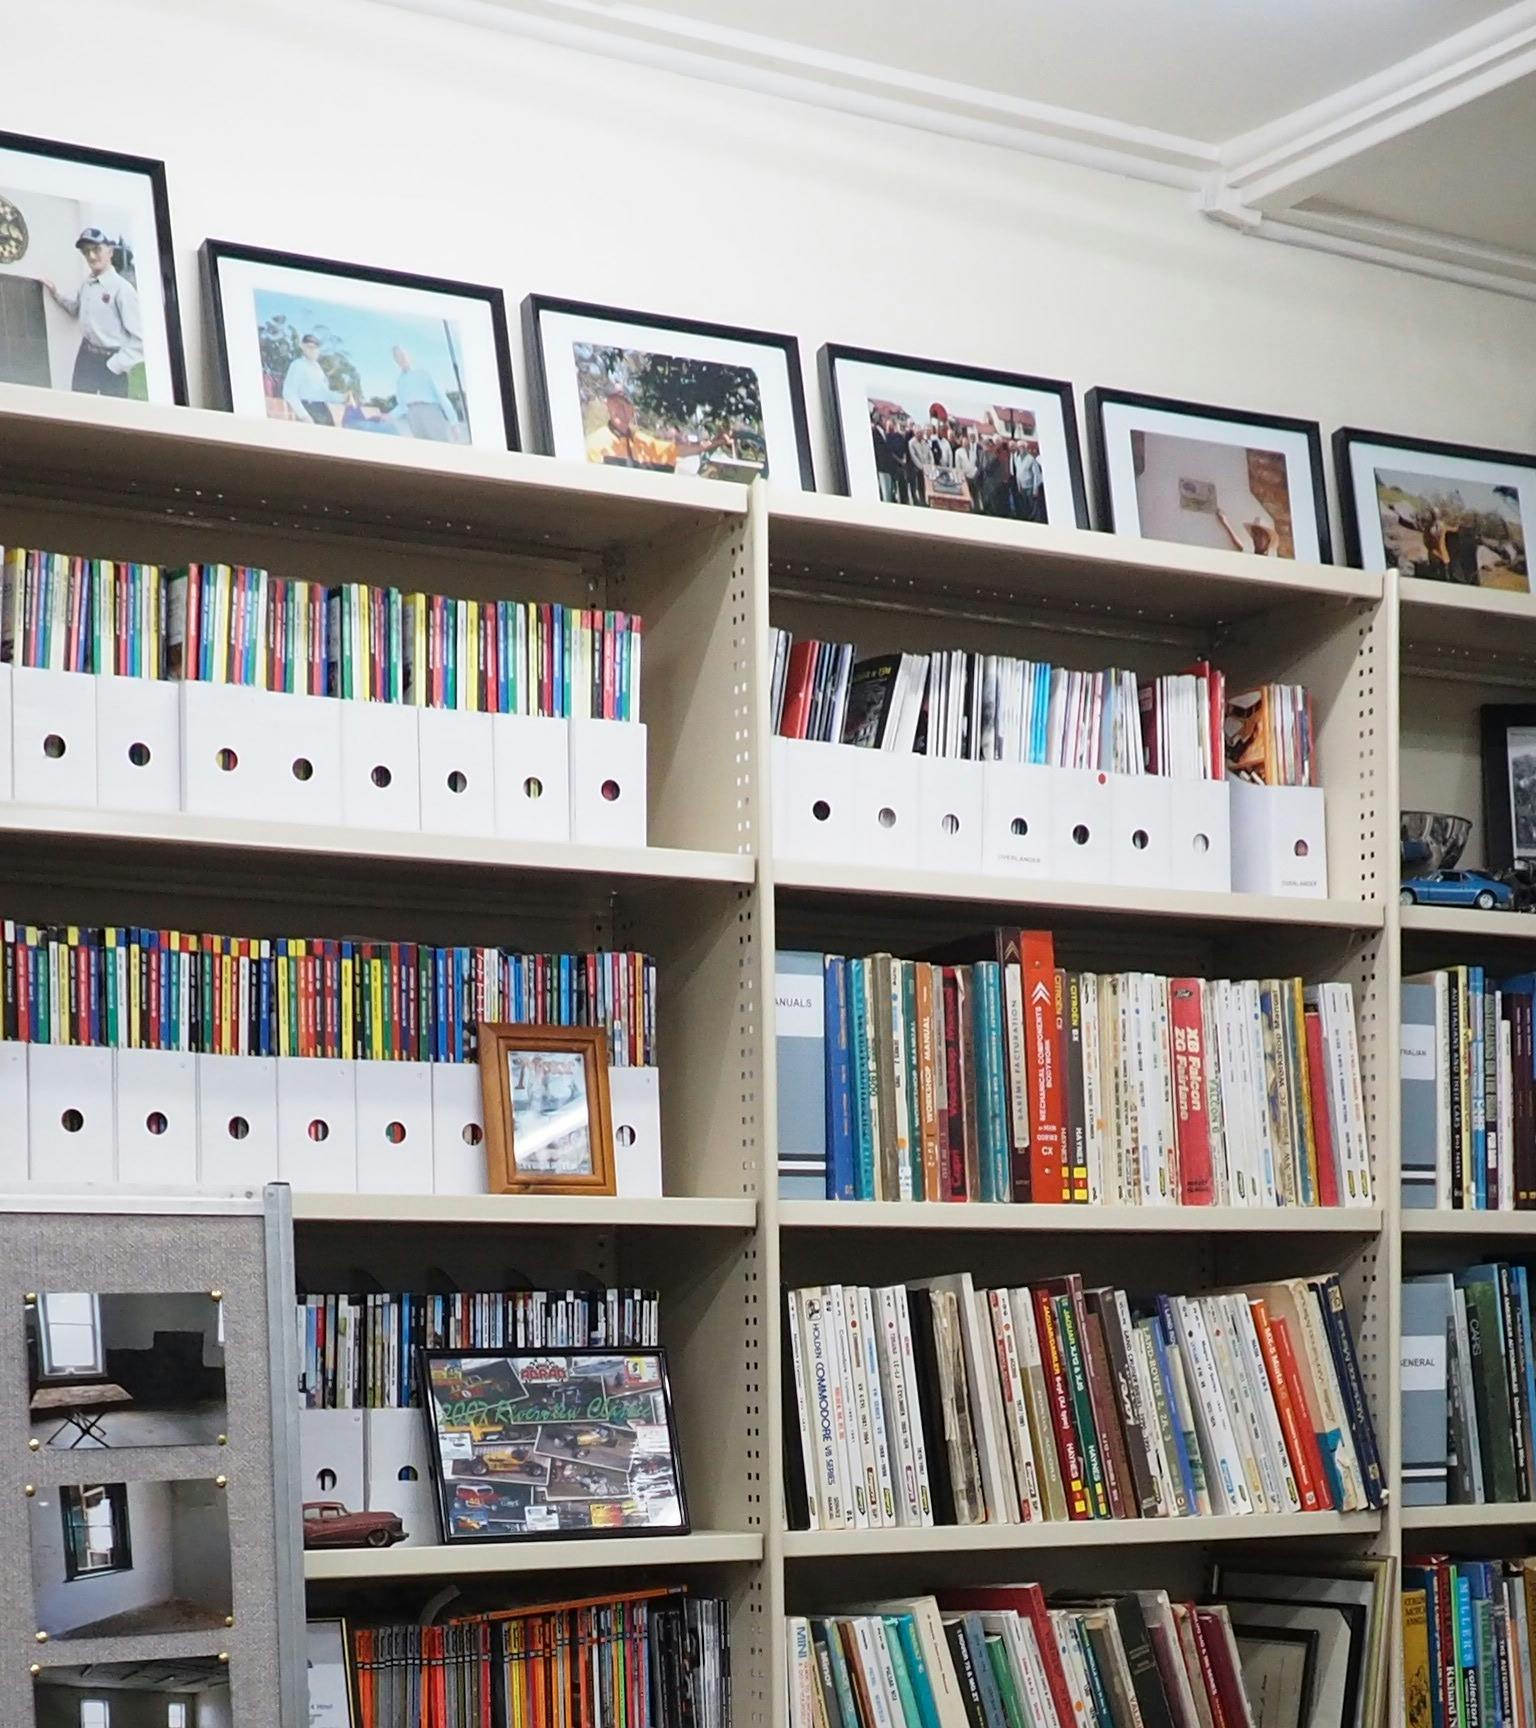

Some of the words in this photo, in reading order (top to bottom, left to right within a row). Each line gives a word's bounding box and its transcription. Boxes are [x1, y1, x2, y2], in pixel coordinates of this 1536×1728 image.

[922, 1016, 931, 1061] MANUAL
[1034, 1007, 1045, 1065] COMPONENTS
[1044, 1039, 1052, 1088] BODYWORK
[1177, 1053, 1189, 1120] Fairlane
[1188, 1056, 1202, 1111] Falcon
[924, 1066, 933, 1123] WORKSHOP
[1037, 1068, 1046, 1121] MECHANICAL
[1060, 1128, 1068, 1163] HAYNES
[1075, 1128, 1084, 1164] HAYNES
[813, 1323, 822, 1359] HOLDEN
[1063, 1309, 1075, 1344] JAGUAR
[1470, 1318, 1481, 1356] CARS
[1142, 1326, 1162, 1397] LAND-ROVER
[815, 1362, 832, 1442] COMMODORE
[1065, 1442, 1078, 1479] HAYNES
[1088, 1445, 1101, 1482] HAYNES
[796, 1626, 807, 1658] MINI
[820, 1651, 833, 1687] Minor
[1446, 1666, 1458, 1715] Richard
[1500, 1659, 1511, 1716] AUTOMOBILE
[1467, 1669, 1480, 1727] collectors
